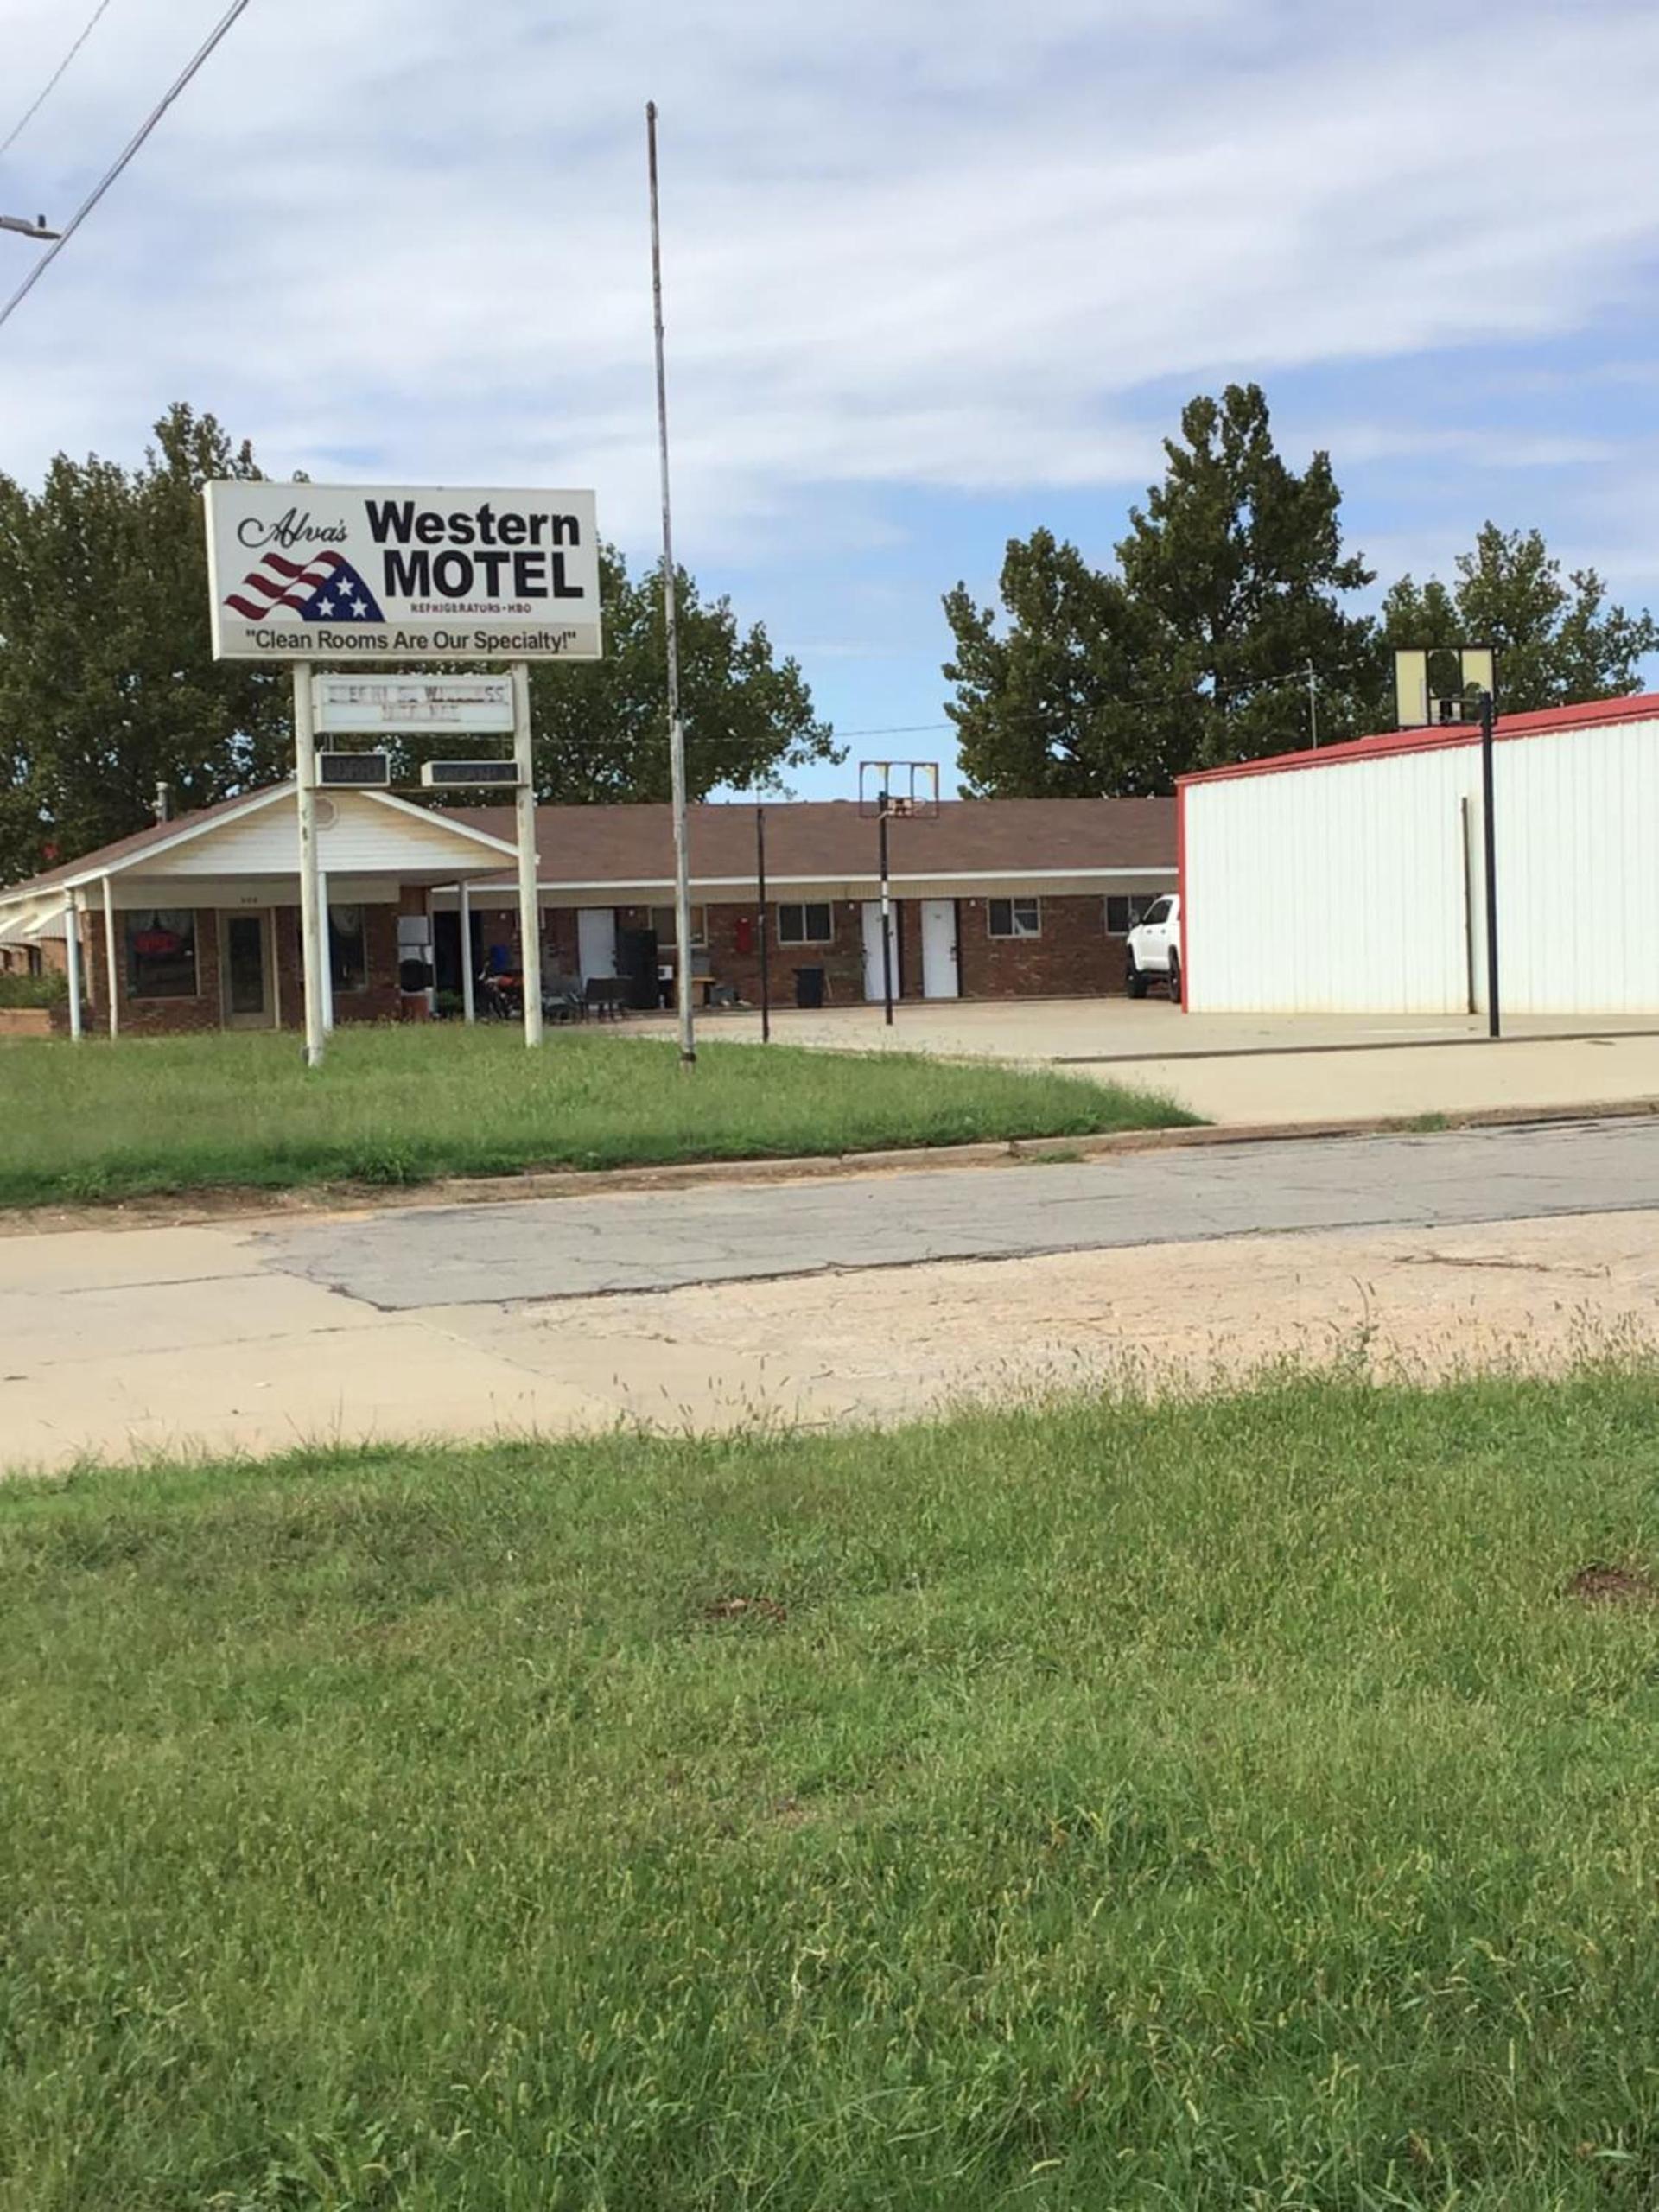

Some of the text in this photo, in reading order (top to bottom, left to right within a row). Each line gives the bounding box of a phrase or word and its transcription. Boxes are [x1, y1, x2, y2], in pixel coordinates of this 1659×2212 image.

[238, 507, 348, 549] Alva's
[365, 499, 580, 546] Western
[383, 549, 584, 598] MOTEL
[317, 630, 388, 650] Rooms
[393, 631, 428, 650] Are
[433, 631, 469, 650] Our
